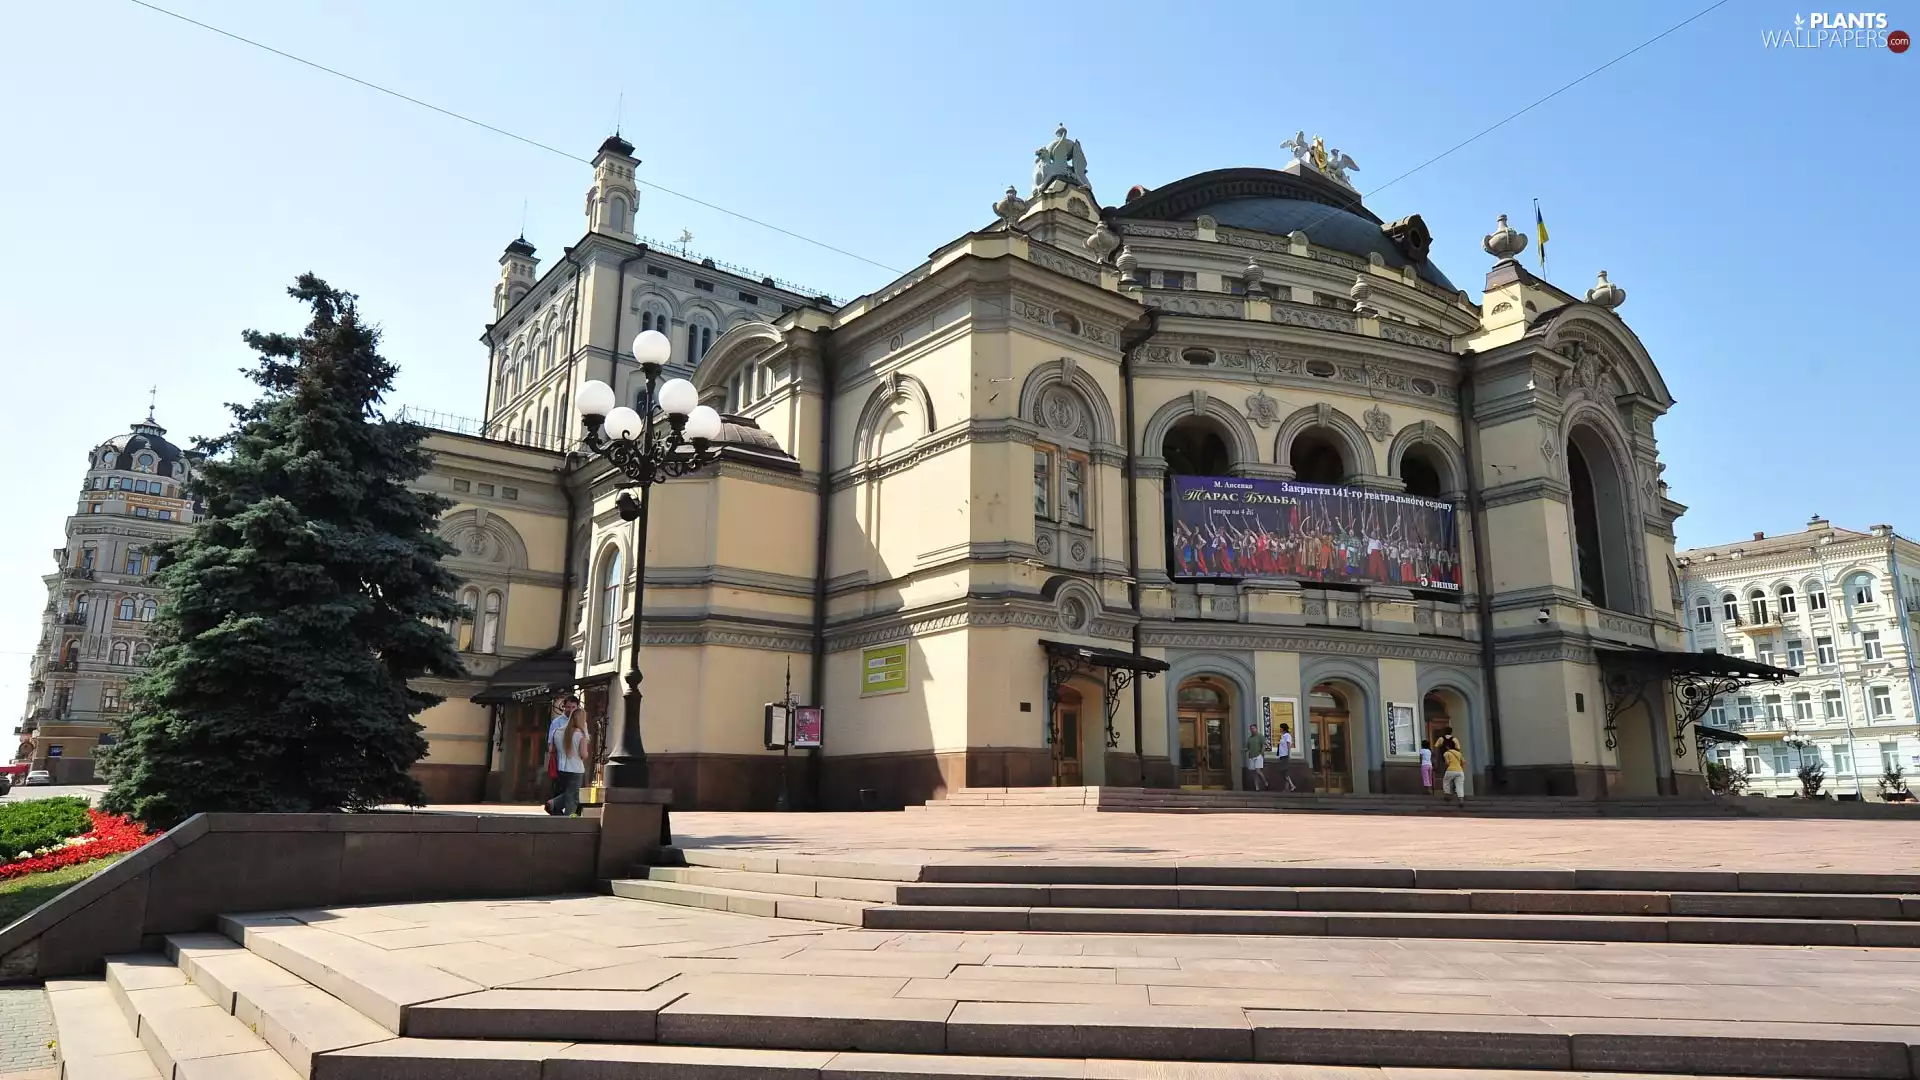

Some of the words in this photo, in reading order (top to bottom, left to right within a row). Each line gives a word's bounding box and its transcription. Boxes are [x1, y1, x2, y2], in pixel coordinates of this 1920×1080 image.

[1281, 482, 1331, 496] Закриття
[1332, 487, 1363, 498] 141-го
[1364, 491, 1424, 507] театрального
[1425, 500, 1453, 512] сезону
[1420, 573, 1429, 587] 5
[1431, 580, 1459, 591] липня
